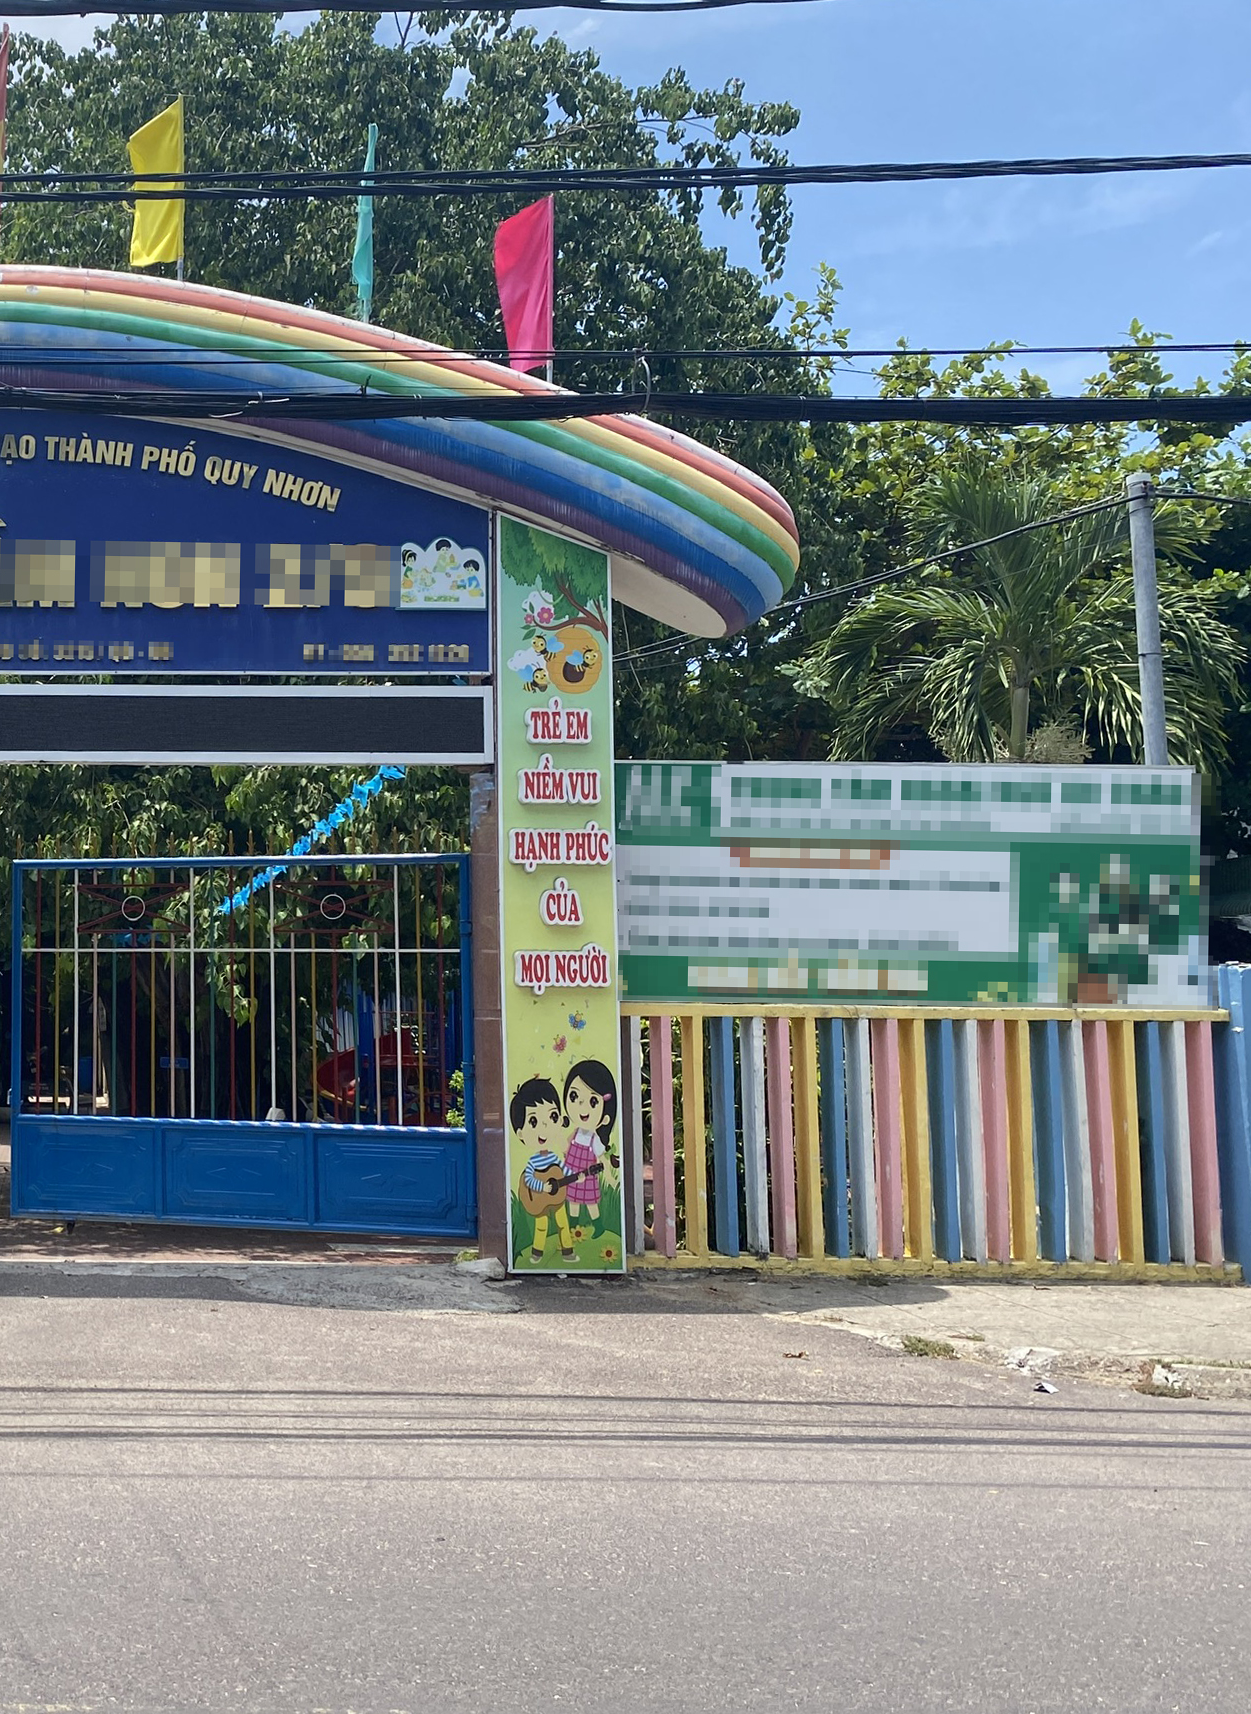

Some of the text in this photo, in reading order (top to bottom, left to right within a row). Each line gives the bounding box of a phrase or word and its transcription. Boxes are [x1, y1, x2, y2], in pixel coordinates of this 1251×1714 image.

[45, 432, 134, 468] THÀNH
[141, 440, 197, 478] PHỐ
[203, 455, 259, 490] QUY
[262, 468, 342, 513] NHƠN
[530, 699, 589, 740] TRẺ EM
[523, 756, 565, 800] NIỀM
[568, 771, 598, 801] VUI
[514, 824, 610, 869] HẠNH PHÚC
[545, 881, 580, 922] CỦA
[520, 946, 608, 992] MỌI NGƯỜI
